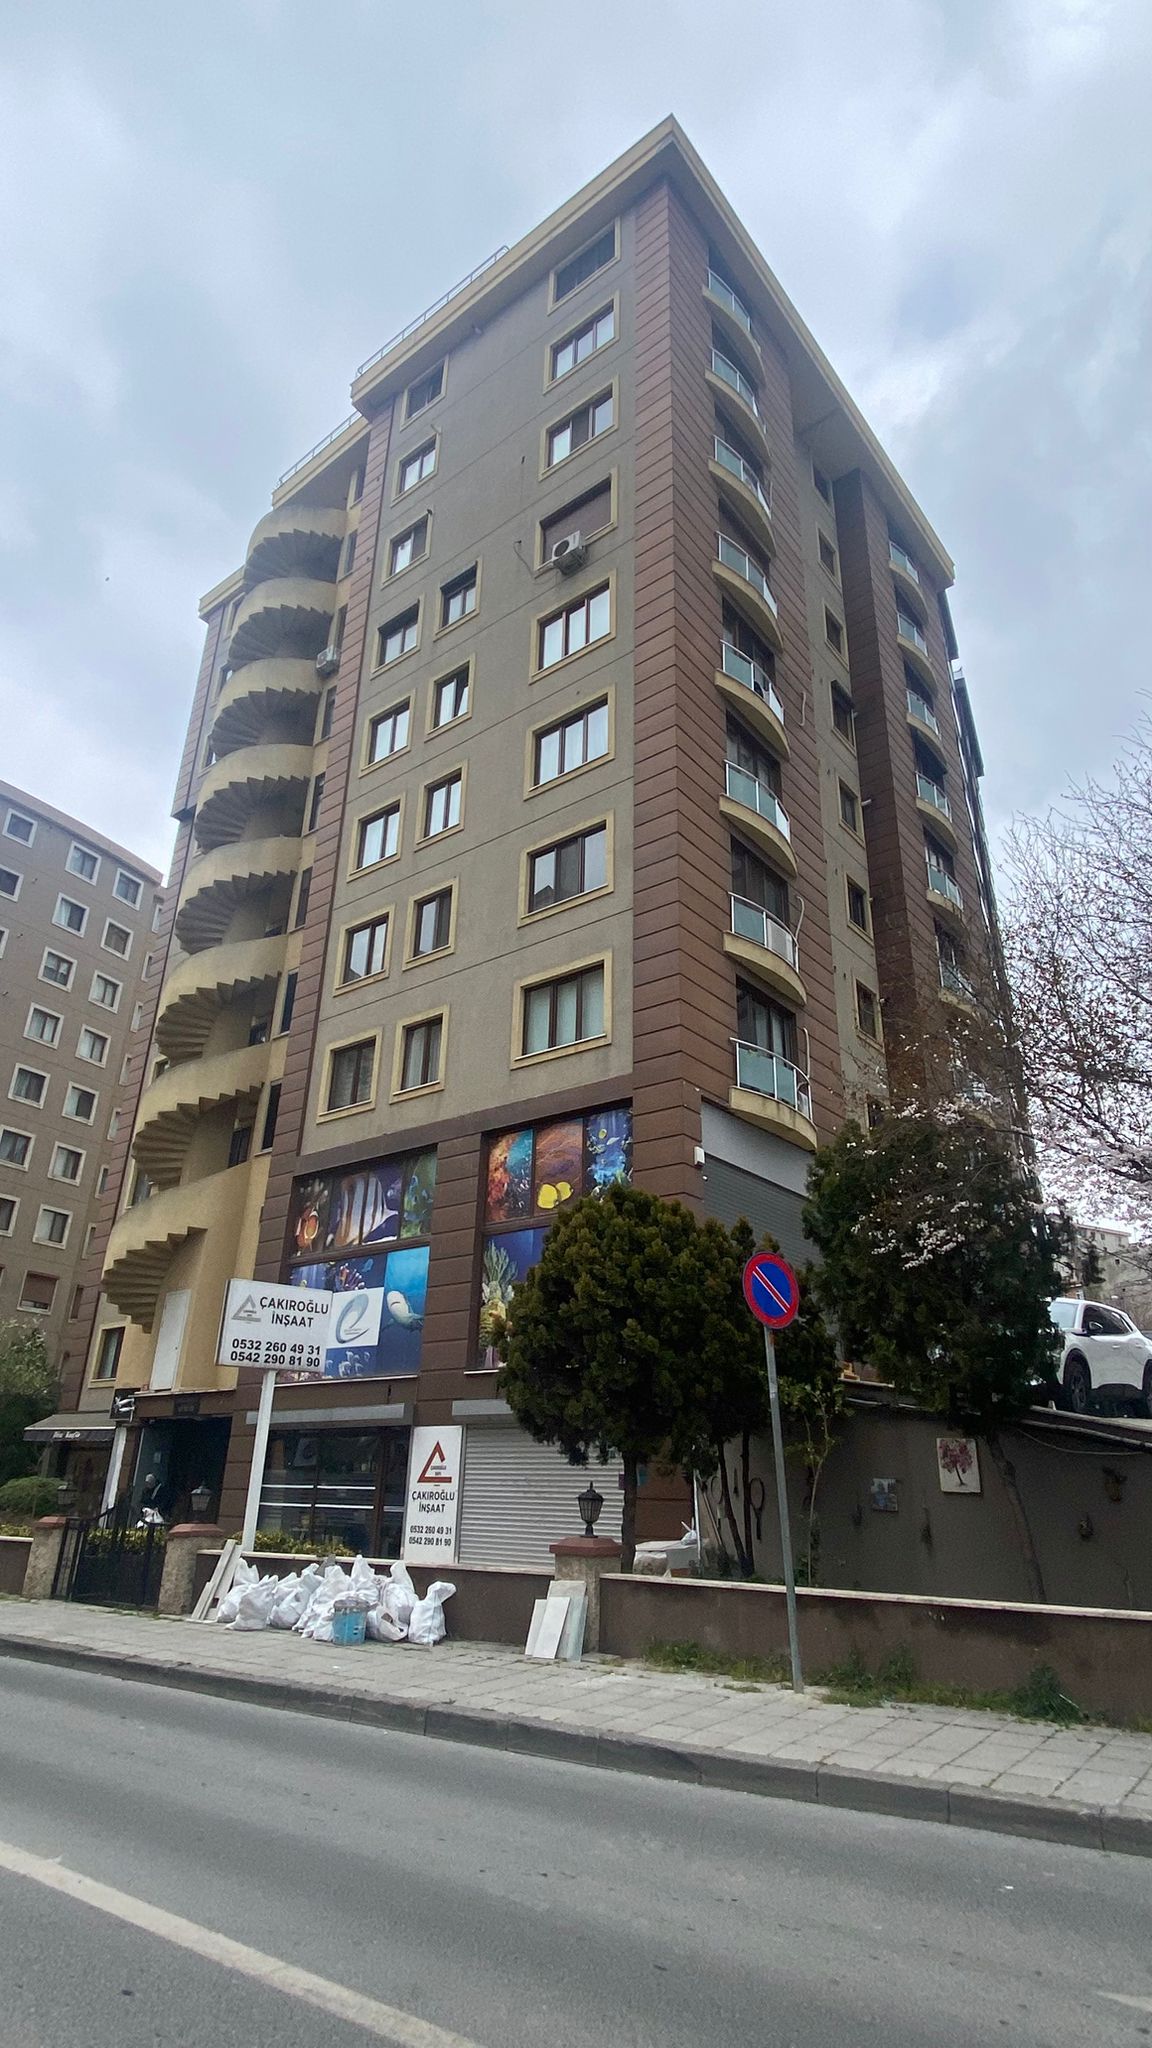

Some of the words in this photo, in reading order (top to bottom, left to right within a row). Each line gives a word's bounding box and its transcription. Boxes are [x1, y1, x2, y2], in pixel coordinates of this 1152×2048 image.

[260, 1296, 329, 1314] ÇAKIROĞLU
[271, 1312, 315, 1328] İNŞAAT
[232, 1338, 262, 1351] 0532
[266, 1341, 287, 1353] 260
[290, 1343, 304, 1354] 49
[307, 1345, 321, 1355] 31
[230, 1351, 260, 1363] 0542
[263, 1353, 285, 1365] 290
[288, 1355, 302, 1366] 81
[306, 1357, 320, 1368] 90
[411, 1490, 455, 1501] ÇAKIROĞLU
[419, 1502, 446, 1513] İNŞAAT
[410, 1525, 424, 1534] 0532
[437, 1526, 445, 1535] 49
[446, 1527, 452, 1535] 31
[409, 1536, 422, 1545] 0542
[424, 1537, 434, 1545] 290
[435, 1537, 442, 1546] 81
[444, 1538, 451, 1546] 90
